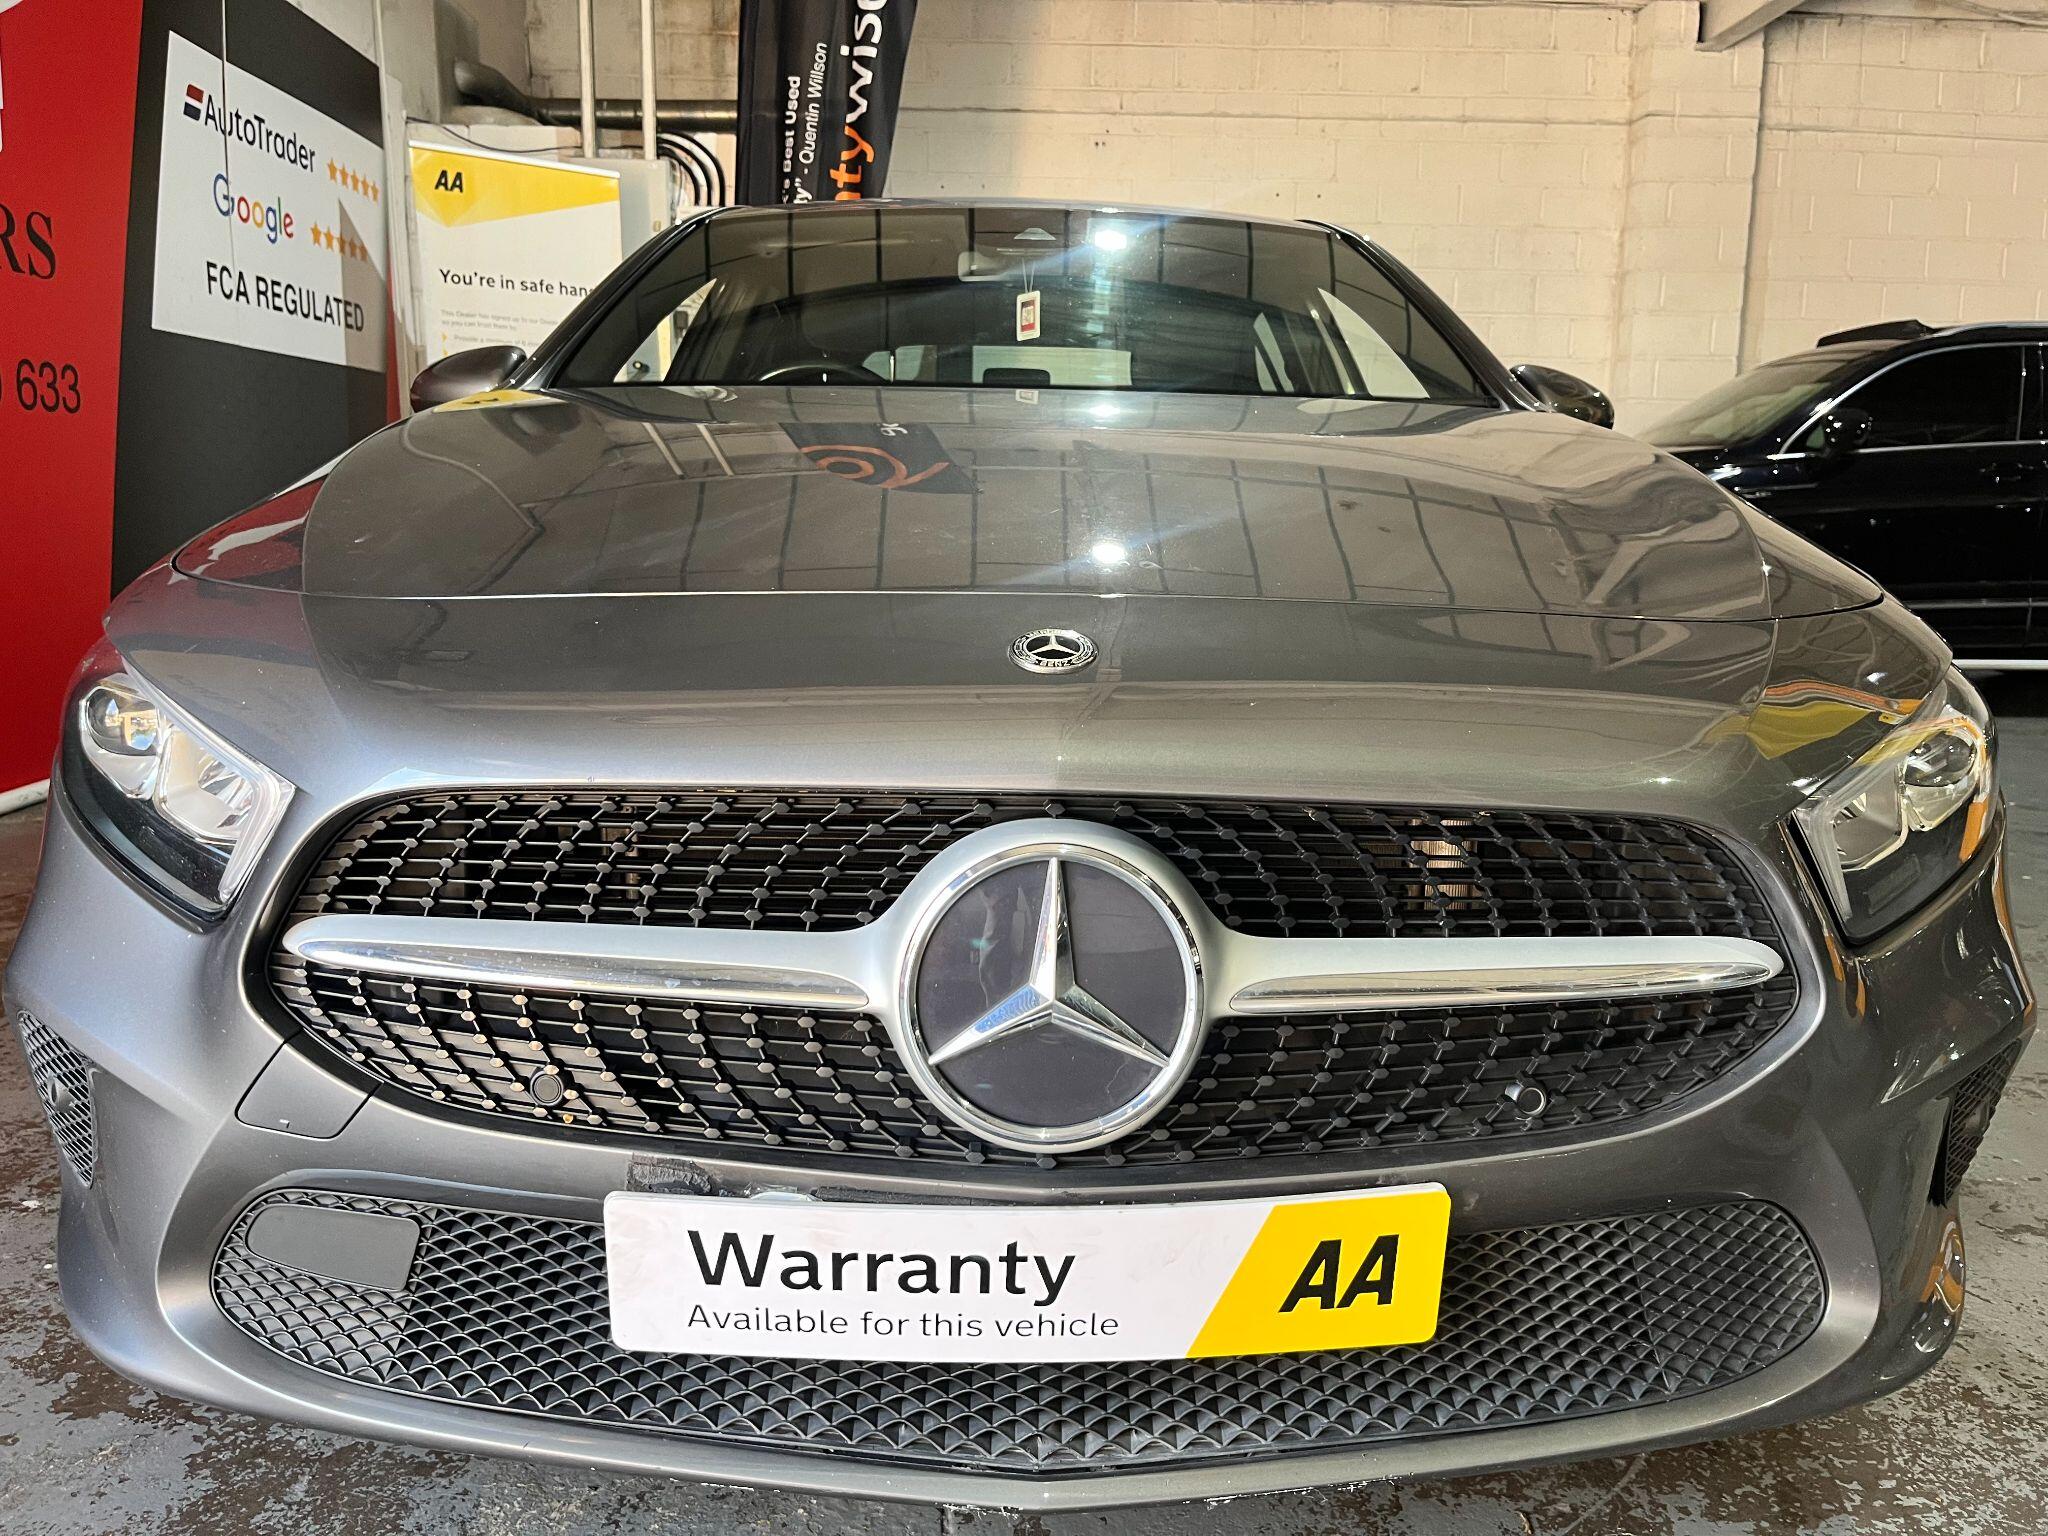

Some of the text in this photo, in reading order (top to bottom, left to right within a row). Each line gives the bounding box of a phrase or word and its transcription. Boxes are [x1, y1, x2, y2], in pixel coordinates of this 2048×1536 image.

[807, 42, 827, 98] Willson
[785, 76, 800, 124] Used
[205, 94, 316, 173] AutoTrader
[799, 103, 820, 164] Quentin
[213, 173, 294, 244] Google
[434, 170, 464, 193] AA
[206, 261, 364, 332] FCA REGULATED
[439, 269, 496, 288] You're
[500, 275, 516, 291] in
[520, 279, 554, 295] safe
[16, 358, 81, 414] 633
[687, 1230, 1076, 1307] Warranty
[1278, 1234, 1400, 1313] AA
[688, 1304, 1120, 1337] Available for this vehicle
